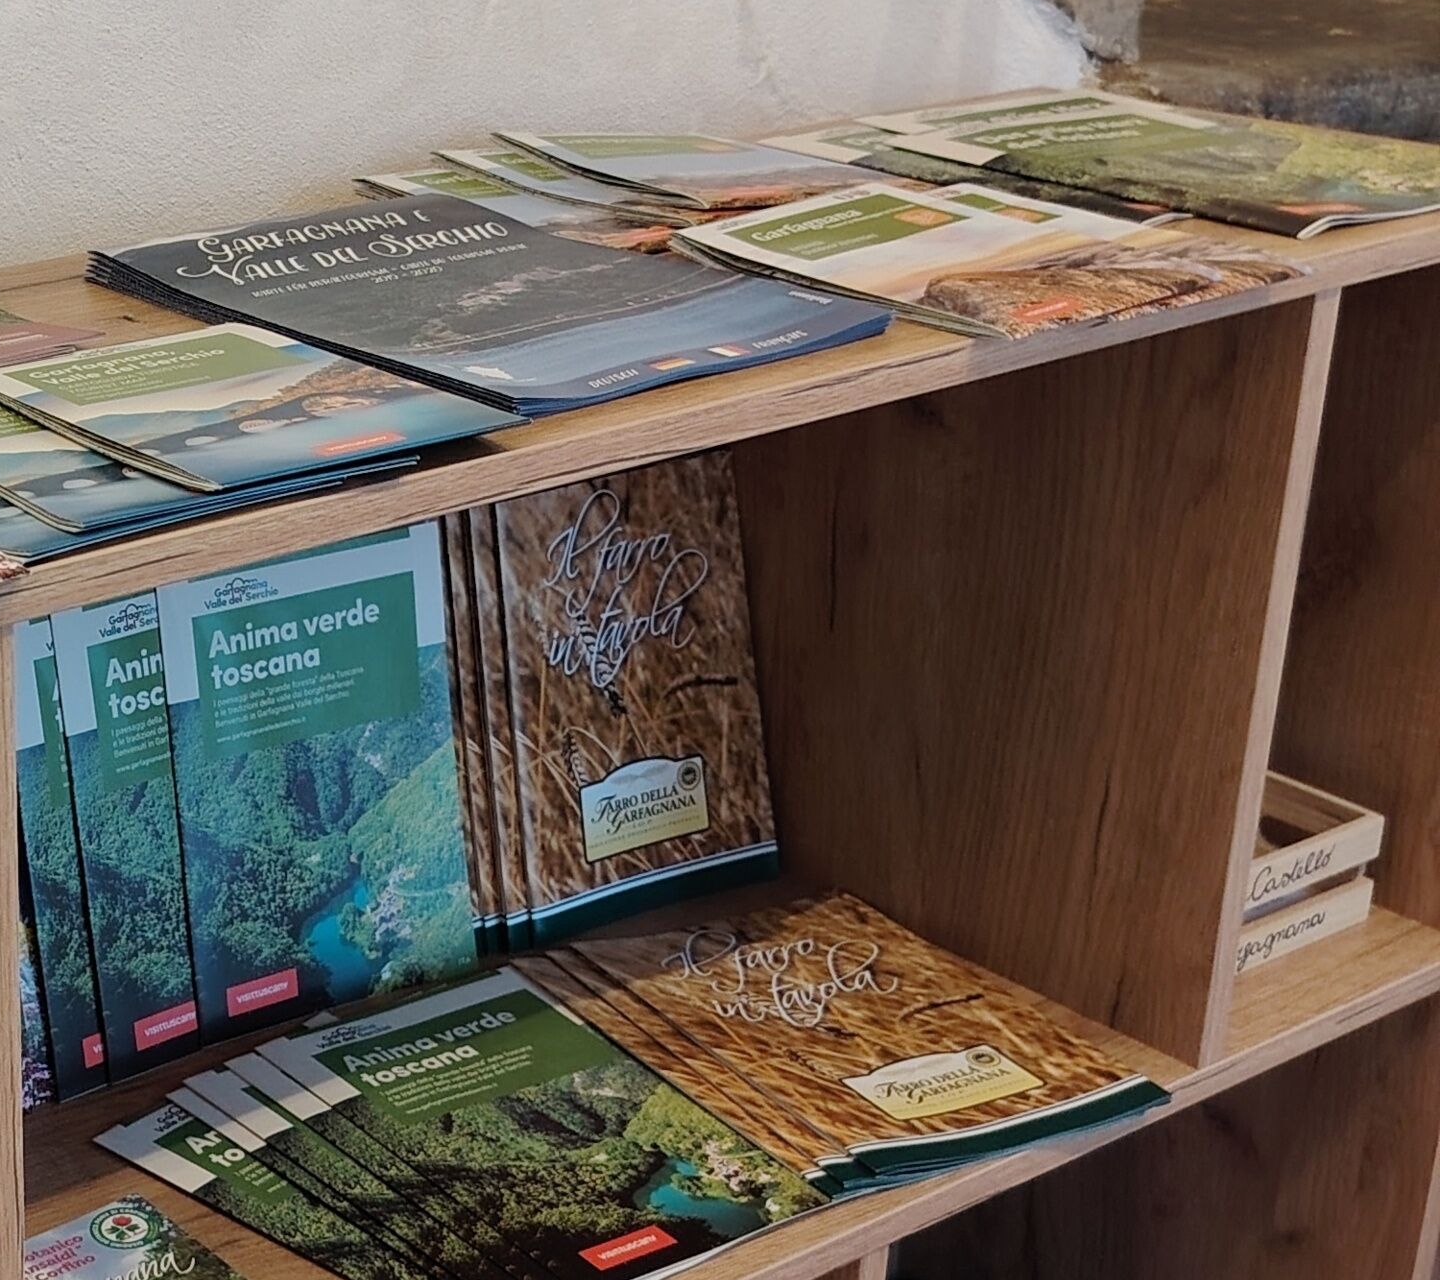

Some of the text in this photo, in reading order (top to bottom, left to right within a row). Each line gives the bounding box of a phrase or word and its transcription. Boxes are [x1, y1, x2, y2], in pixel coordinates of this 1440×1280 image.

[197, 208, 432, 263] GARFAGNANA E
[751, 205, 863, 245] Garfagnana
[176, 254, 309, 286] VALLE
[311, 244, 369, 271] DEL
[367, 220, 509, 259] SERCHIO
[29, 349, 176, 380] Garfagnana,
[41, 347, 226, 387] Valle del Serchio
[543, 489, 671, 618] Il farro
[204, 586, 279, 611] Valle del Serchio
[549, 549, 708, 687] in tavola
[209, 598, 381, 659] Anima verde
[211, 648, 321, 690] toscana
[108, 686, 165, 719] tosc
[591, 784, 678, 824] FARRO DELLA
[606, 794, 696, 835] GARFAGNANA
[1249, 842, 1336, 901] Castello
[661, 929, 814, 995] Il farro
[711, 939, 898, 1028] in tavola
[342, 1010, 517, 1073] Anima verde
[359, 1044, 480, 1088] toscana
[906, 1069, 1012, 1105] GARFAGNANA
[934, 1066, 983, 1084] DELLA
[25, 1234, 84, 1263] otanico
